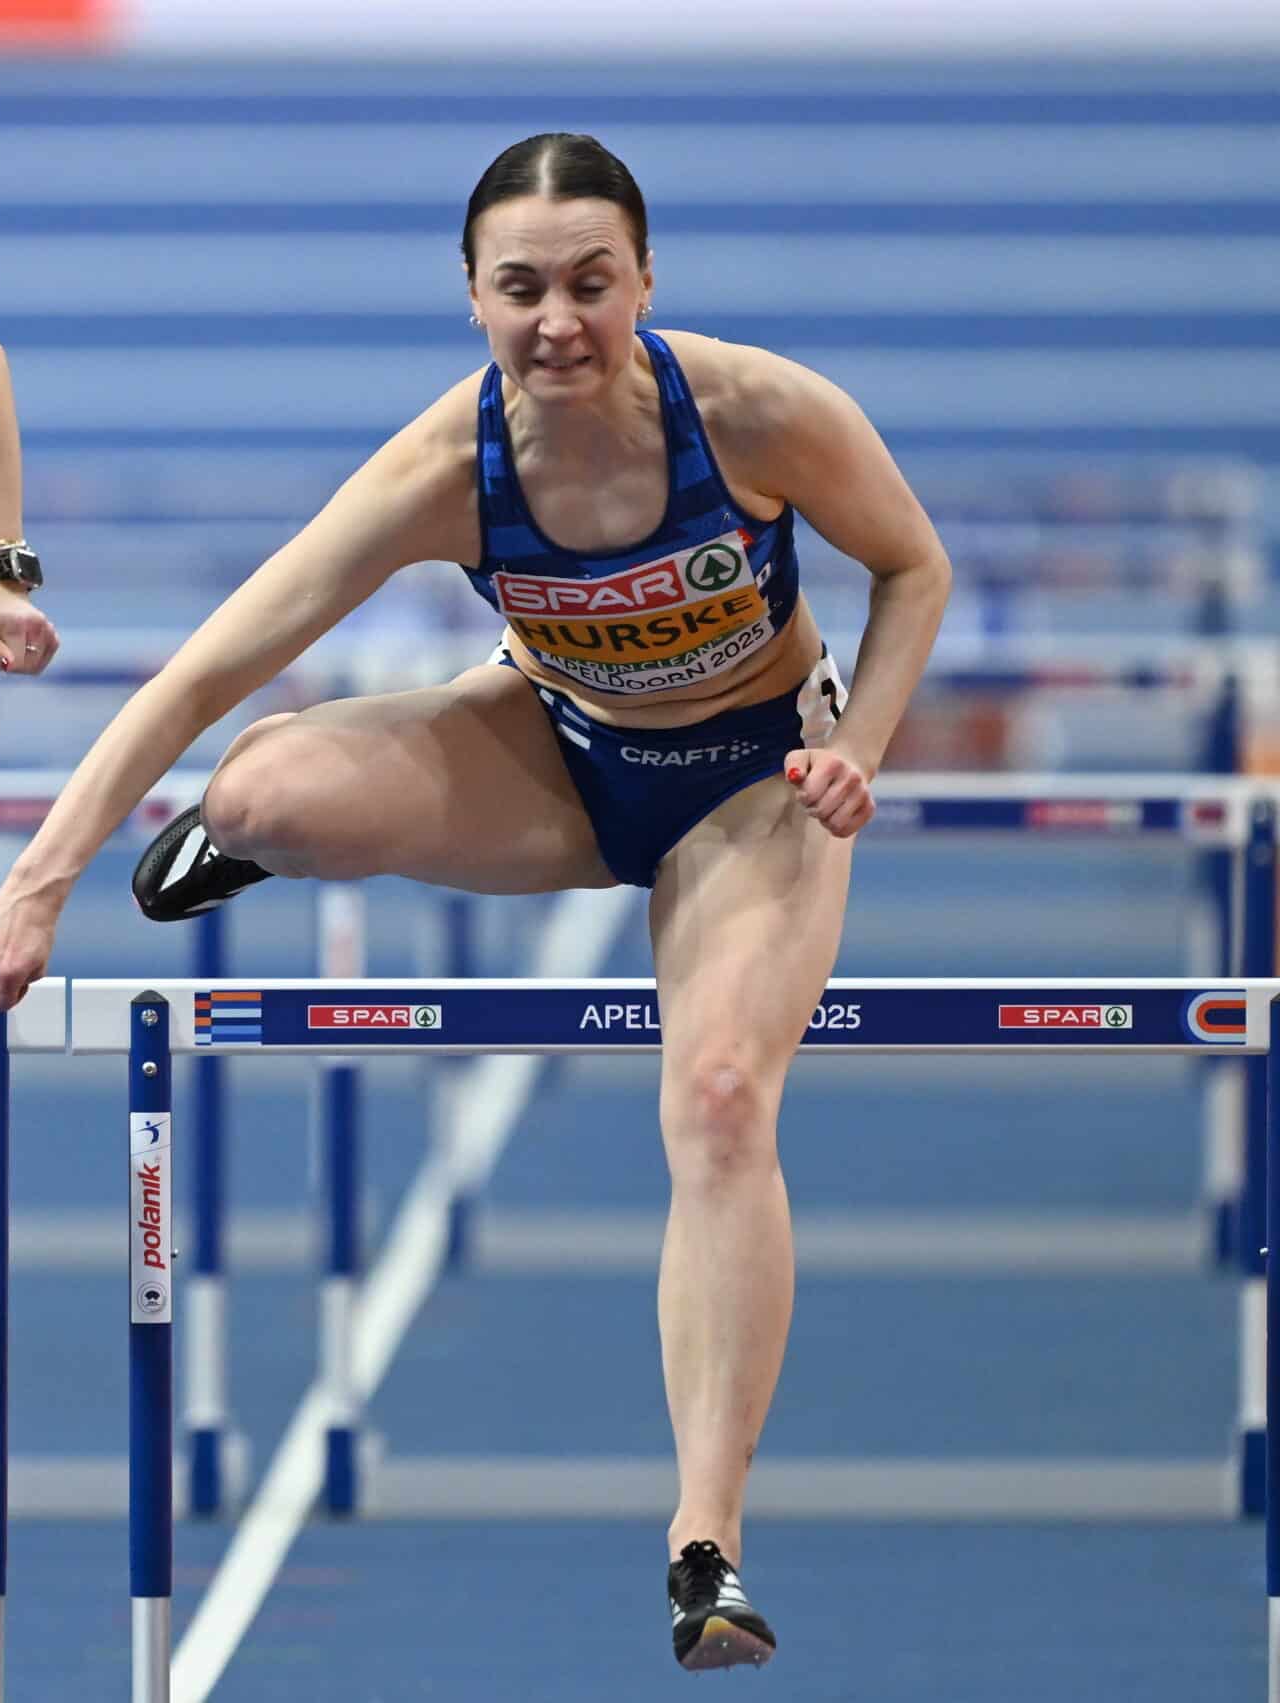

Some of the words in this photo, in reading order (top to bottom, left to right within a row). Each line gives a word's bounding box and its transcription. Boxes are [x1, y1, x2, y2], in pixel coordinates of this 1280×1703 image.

[505, 569, 678, 611] SPAR
[514, 593, 753, 652] HURSKE
[711, 622, 766, 666] 2025
[620, 745, 725, 767] CRAFT
[332, 1009, 408, 1024] SPAR
[808, 1003, 861, 1029] 025
[1023, 1009, 1099, 1024] SPAR
[137, 1163, 167, 1271] polanik
